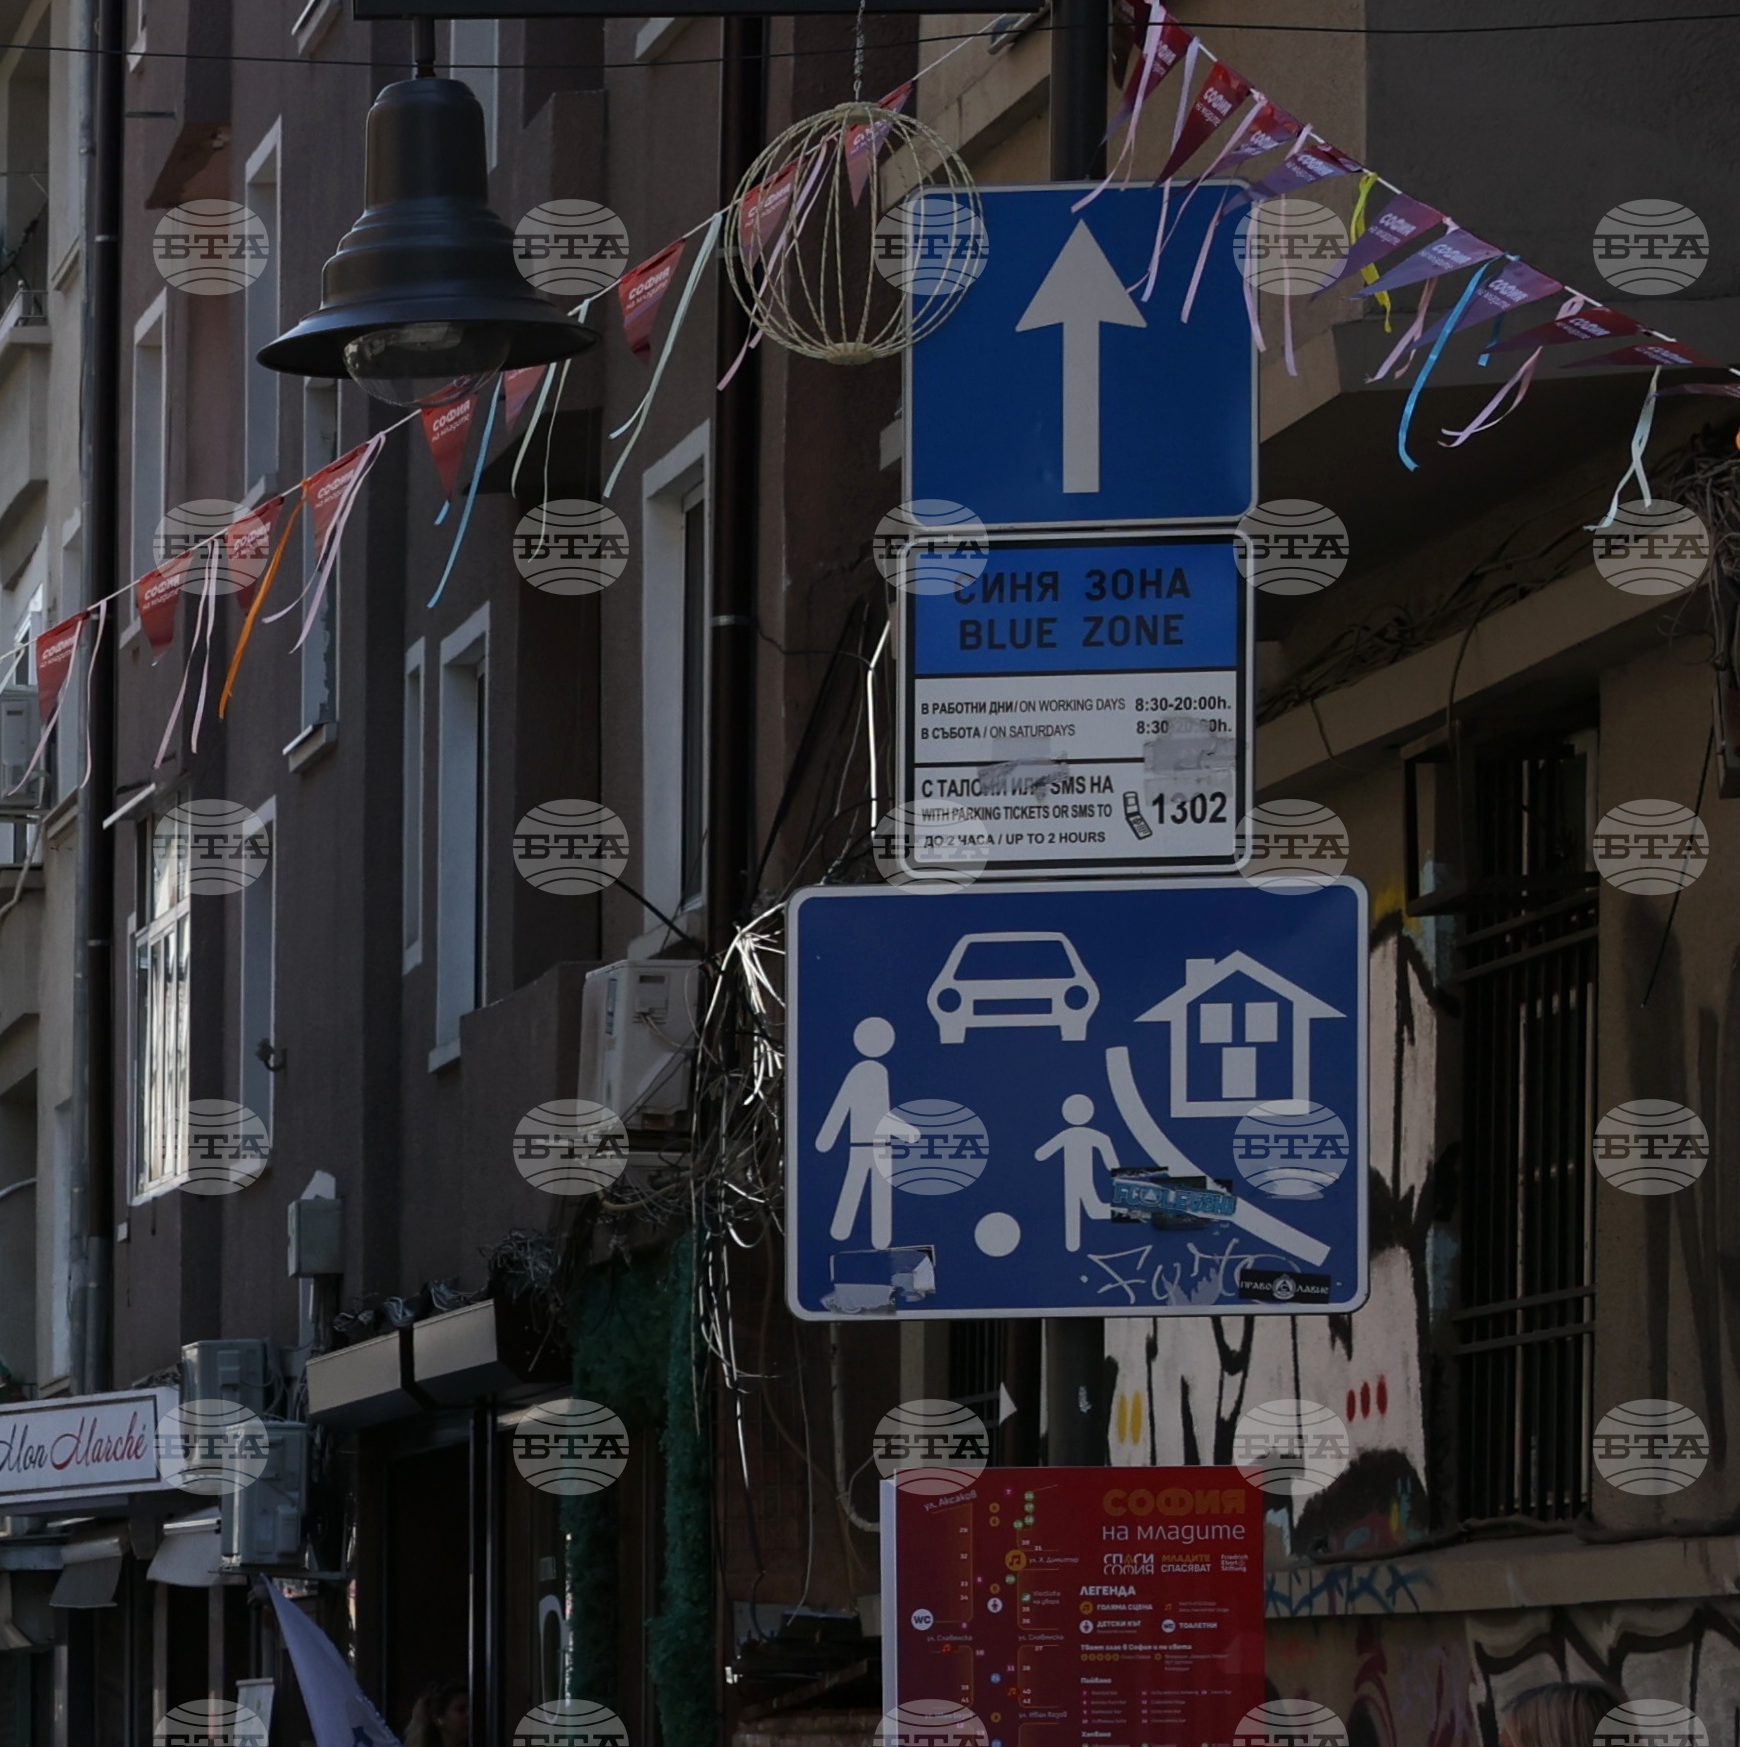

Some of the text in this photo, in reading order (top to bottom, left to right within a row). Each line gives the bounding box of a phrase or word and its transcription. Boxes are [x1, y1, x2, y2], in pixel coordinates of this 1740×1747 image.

[954, 567, 1191, 605] СИНЯ ЗОНА
[959, 614, 1184, 650] BLUE ZONE
[921, 703, 929, 714] В
[932, 702, 986, 714] РАБОТНИ
[1039, 699, 1093, 712] WORKING
[1096, 698, 1126, 711] DAYS
[1135, 696, 1232, 712] 8:30-20:00h.
[921, 728, 929, 739] В
[932, 727, 981, 740] СЪБОТА
[989, 726, 1006, 738] ON
[1009, 724, 1076, 738] SATURDAYS
[1050, 776, 1085, 794] SMS
[1090, 776, 1114, 793] НА
[922, 804, 1112, 822] WITH PARKING TICKETS OR SMS TO
[1152, 791, 1227, 824] 1302
[958, 835, 995, 846] ЧАСА
[1006, 834, 1024, 845] UP
[1027, 834, 1045, 844] TO
[1048, 833, 1056, 844] 2
[1059, 832, 1106, 844] HOURS
[1102, 1488, 1246, 1516] СОФИЯ
[1103, 1524, 1246, 1544] на младите
[1080, 1585, 1136, 1597] ЛЕГЕНДА
[914, 1616, 931, 1624] WC
